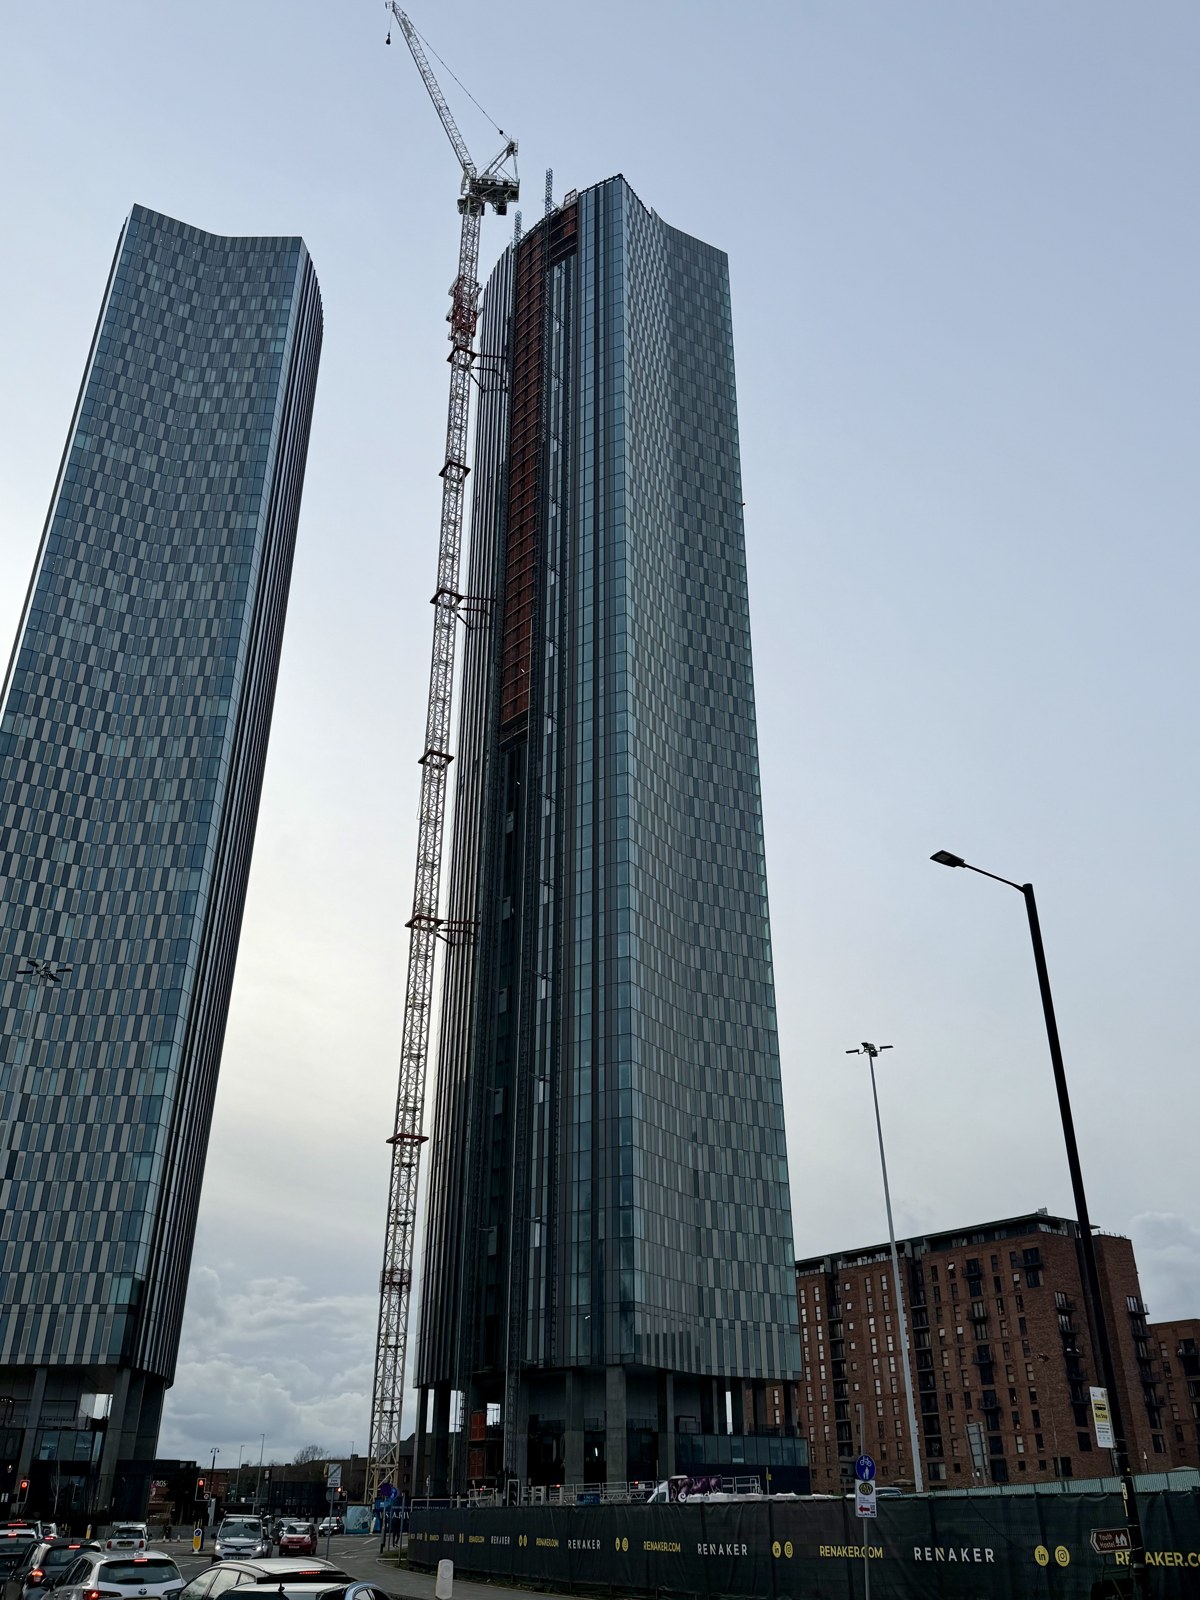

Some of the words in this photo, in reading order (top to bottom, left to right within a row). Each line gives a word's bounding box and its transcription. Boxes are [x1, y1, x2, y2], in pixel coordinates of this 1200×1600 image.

[1098, 1533, 1113, 1541] Youth
[567, 1539, 601, 1550] RENAKER
[643, 1541, 681, 1553] RENAKER.COM
[697, 1543, 748, 1556] RENAKER
[913, 1546, 995, 1563] RENAKER
